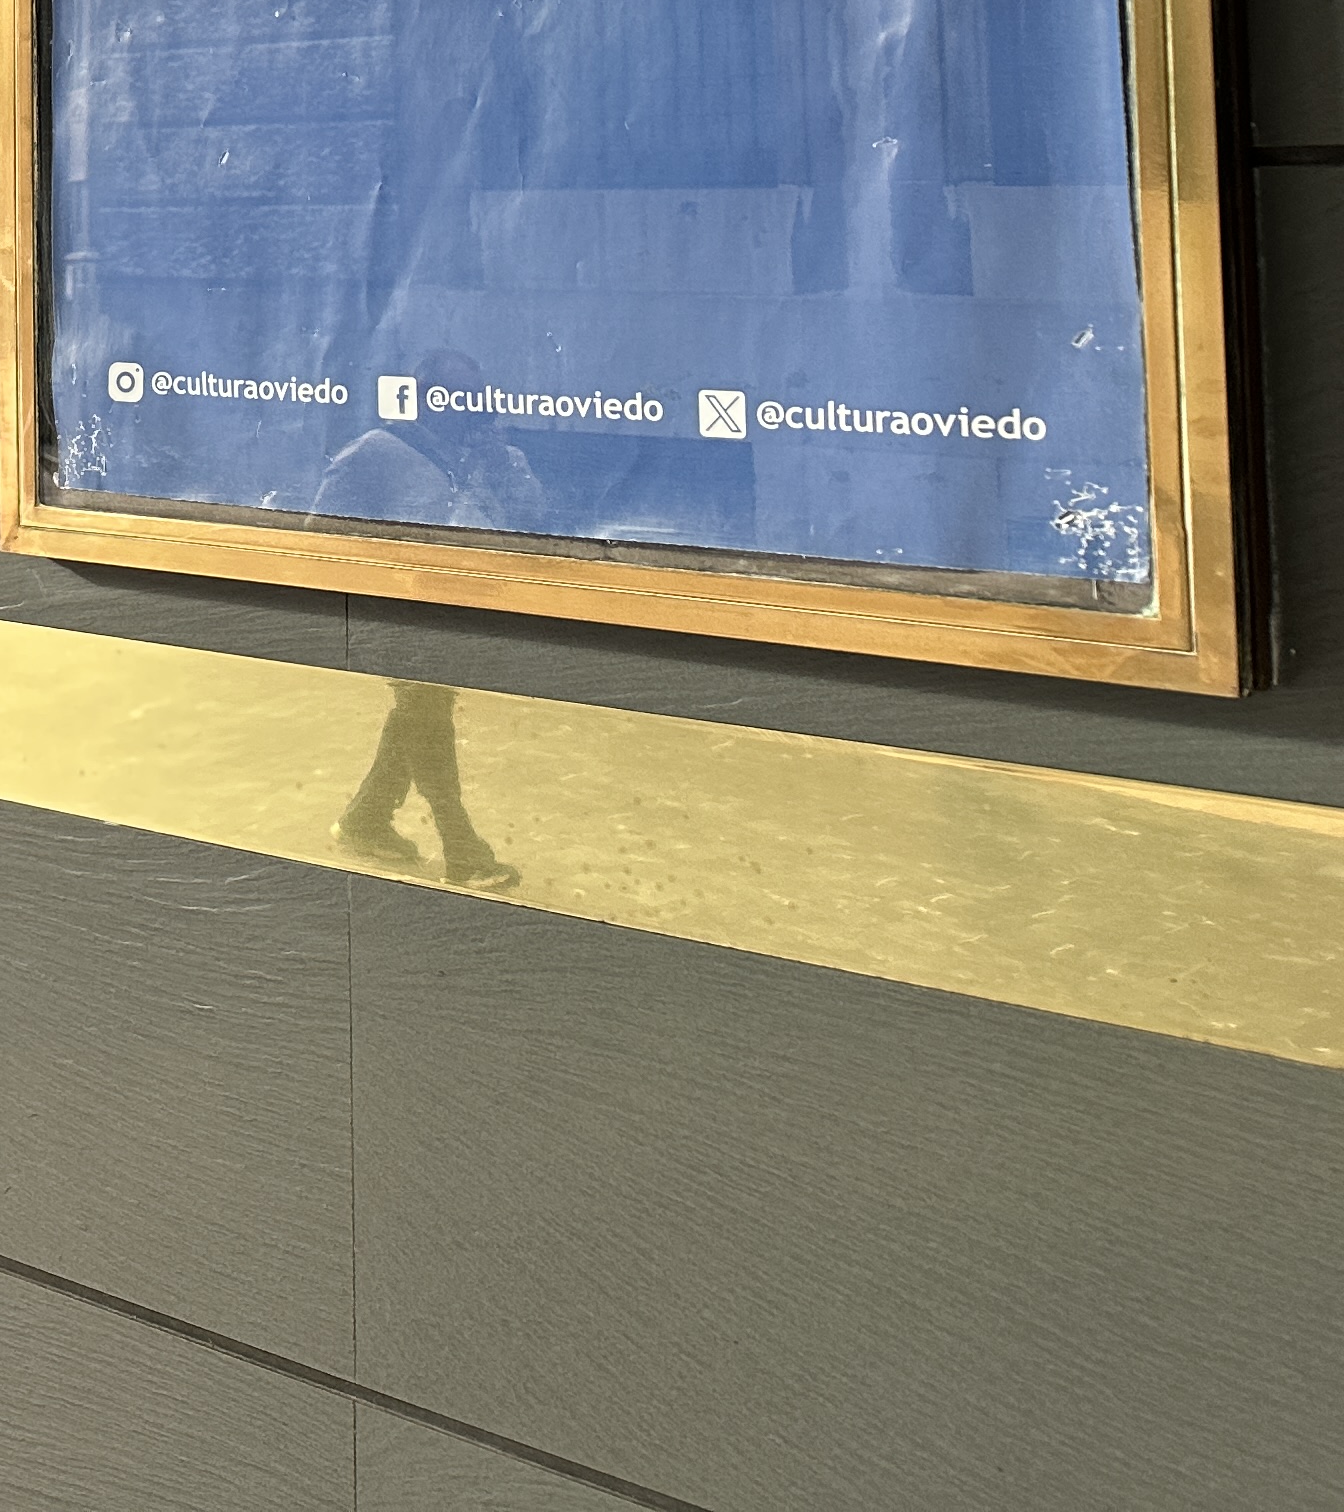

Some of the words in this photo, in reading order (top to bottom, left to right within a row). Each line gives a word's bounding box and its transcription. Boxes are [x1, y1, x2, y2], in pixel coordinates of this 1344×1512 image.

[150, 369, 350, 406] @culturaoviedo
[425, 383, 665, 423] @culturaoviedo
[755, 399, 1048, 442] @culturaoviedo
